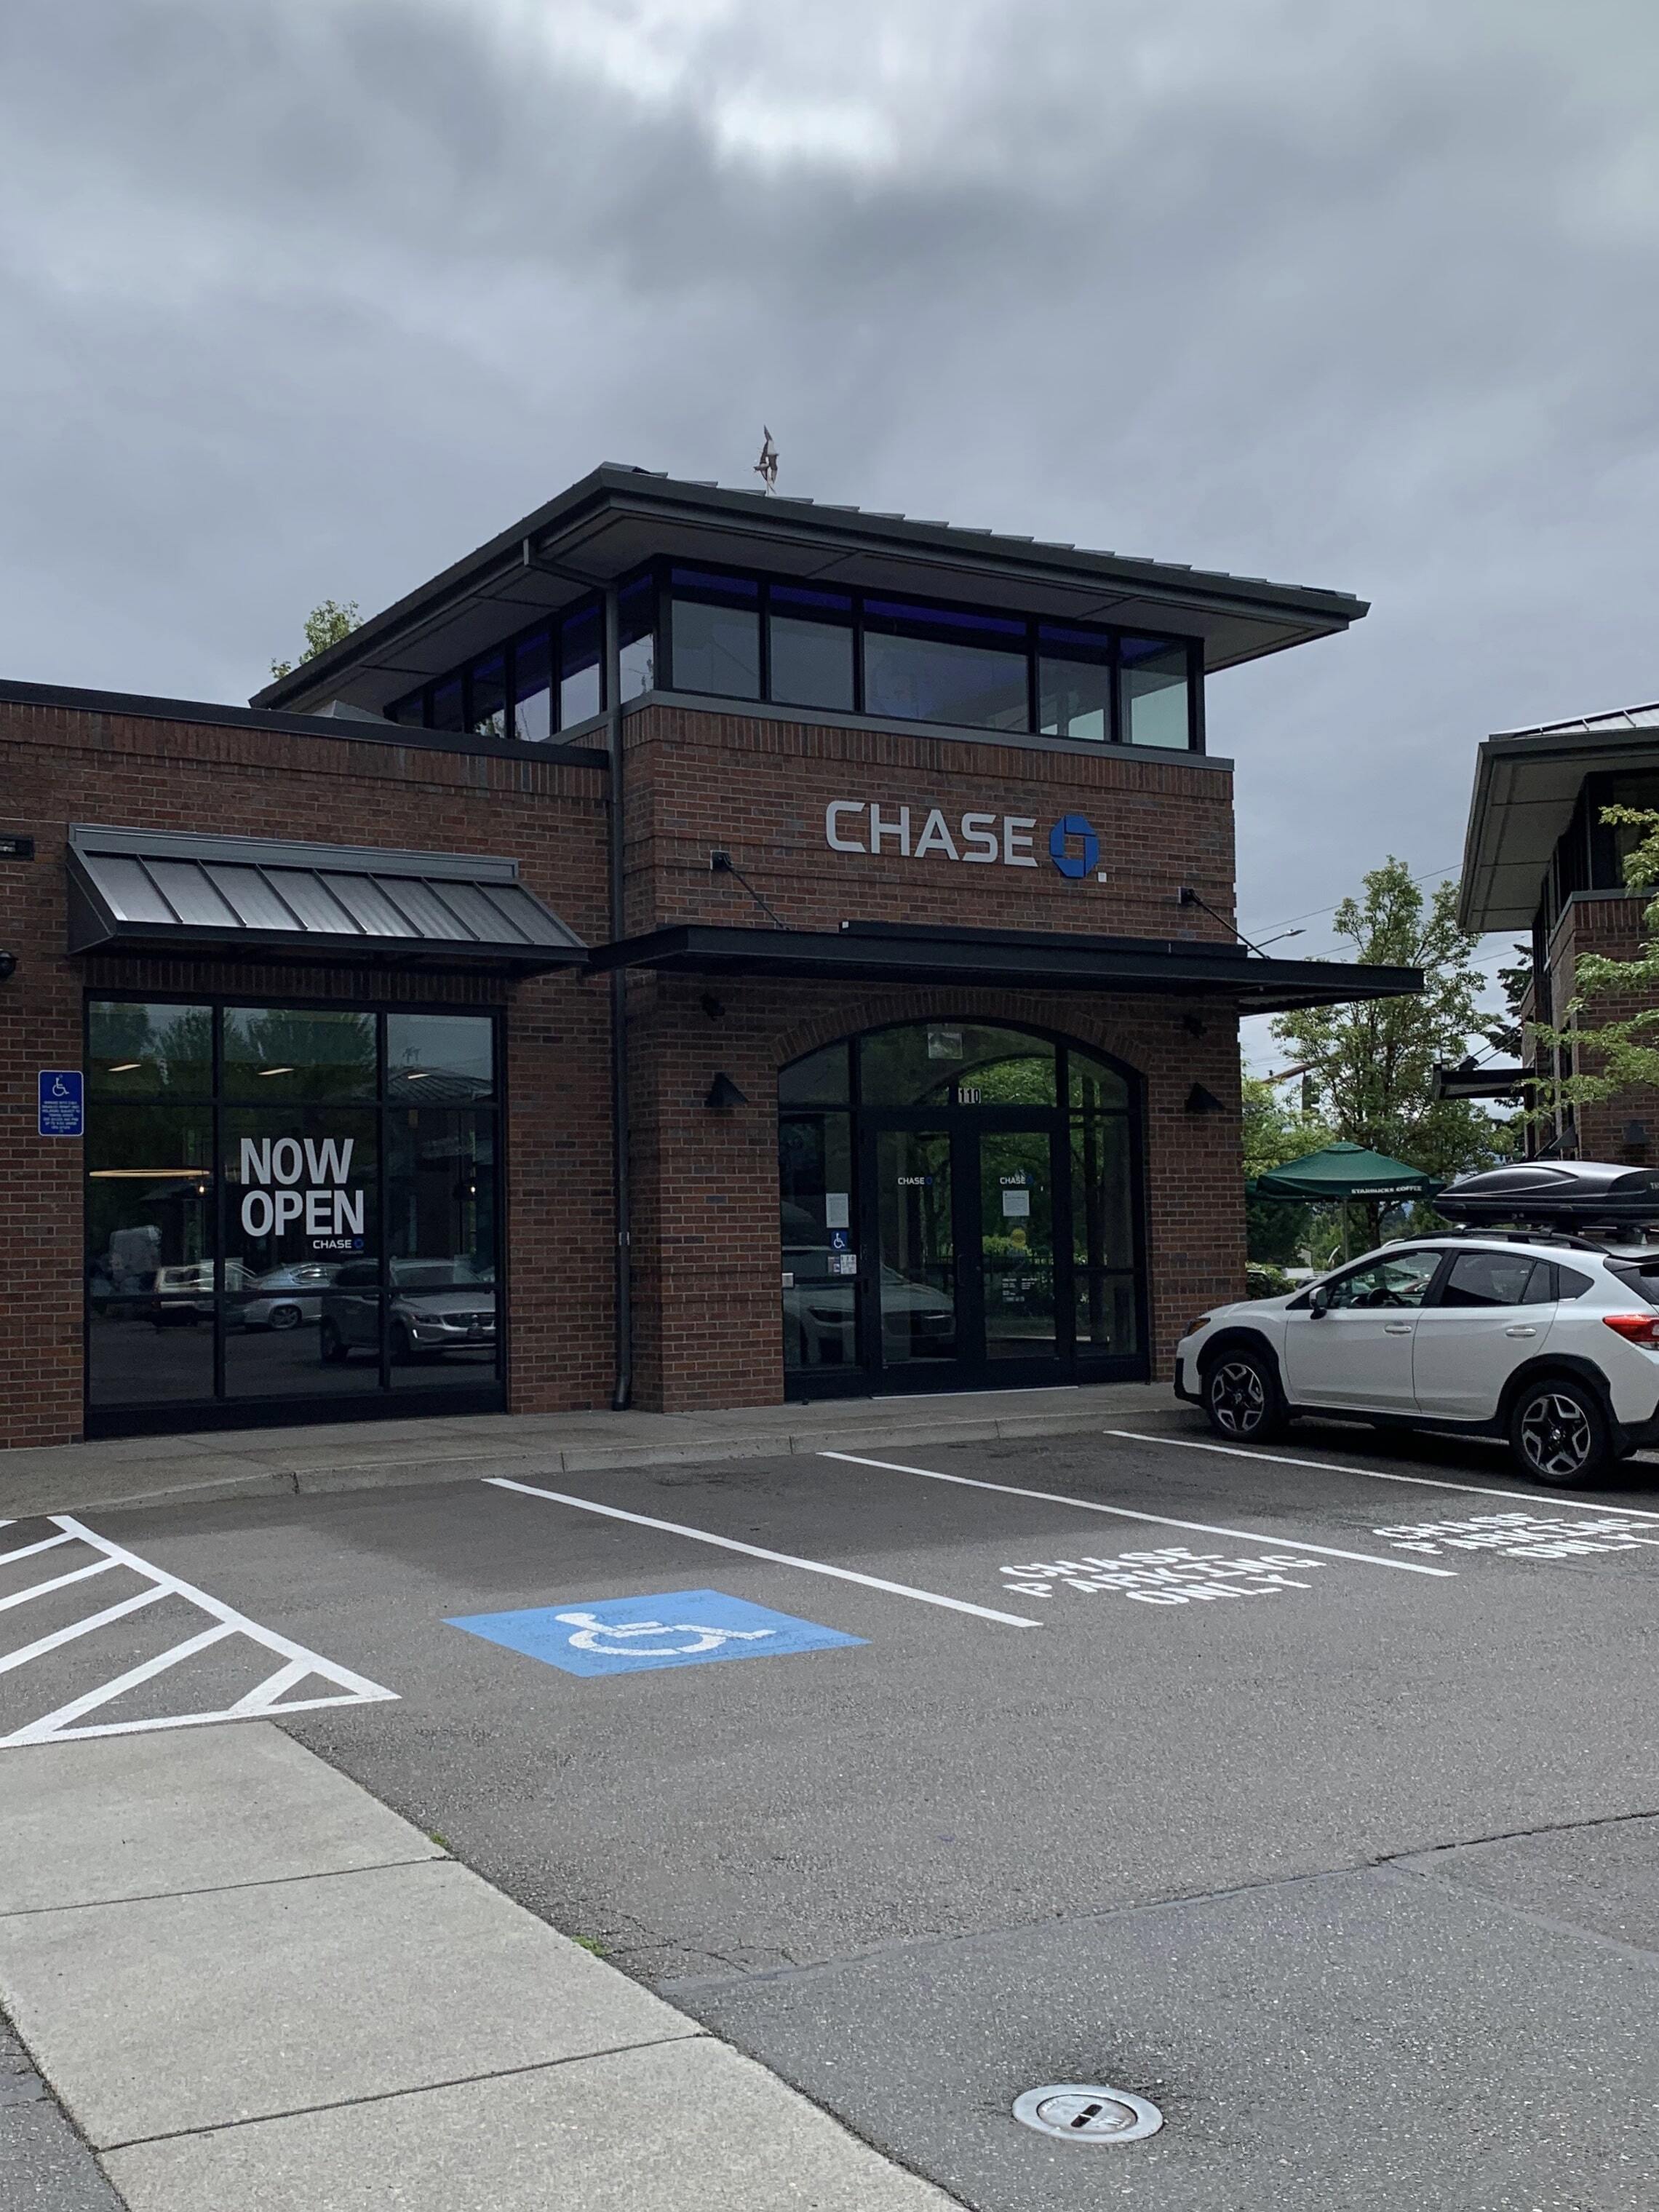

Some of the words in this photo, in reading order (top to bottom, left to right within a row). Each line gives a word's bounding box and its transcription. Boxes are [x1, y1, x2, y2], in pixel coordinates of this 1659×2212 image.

[826, 800, 1038, 868] CHASE
[958, 1088, 982, 1104] 110
[240, 1137, 354, 1185] NOW
[898, 1177, 925, 1185] CHASE
[1000, 1177, 1026, 1185] CHASE
[241, 1190, 364, 1237] OPEN
[313, 1239, 352, 1249] CHASE
[1372, 1513, 1564, 1540] CHASE
[1391, 1519, 1656, 1555] PARKING
[1505, 1533, 1659, 1559] ONLY
[999, 1547, 1225, 1578] CHASE
[1002, 1554, 1327, 1598] PARKING
[1125, 1574, 1312, 1605] ONLY
